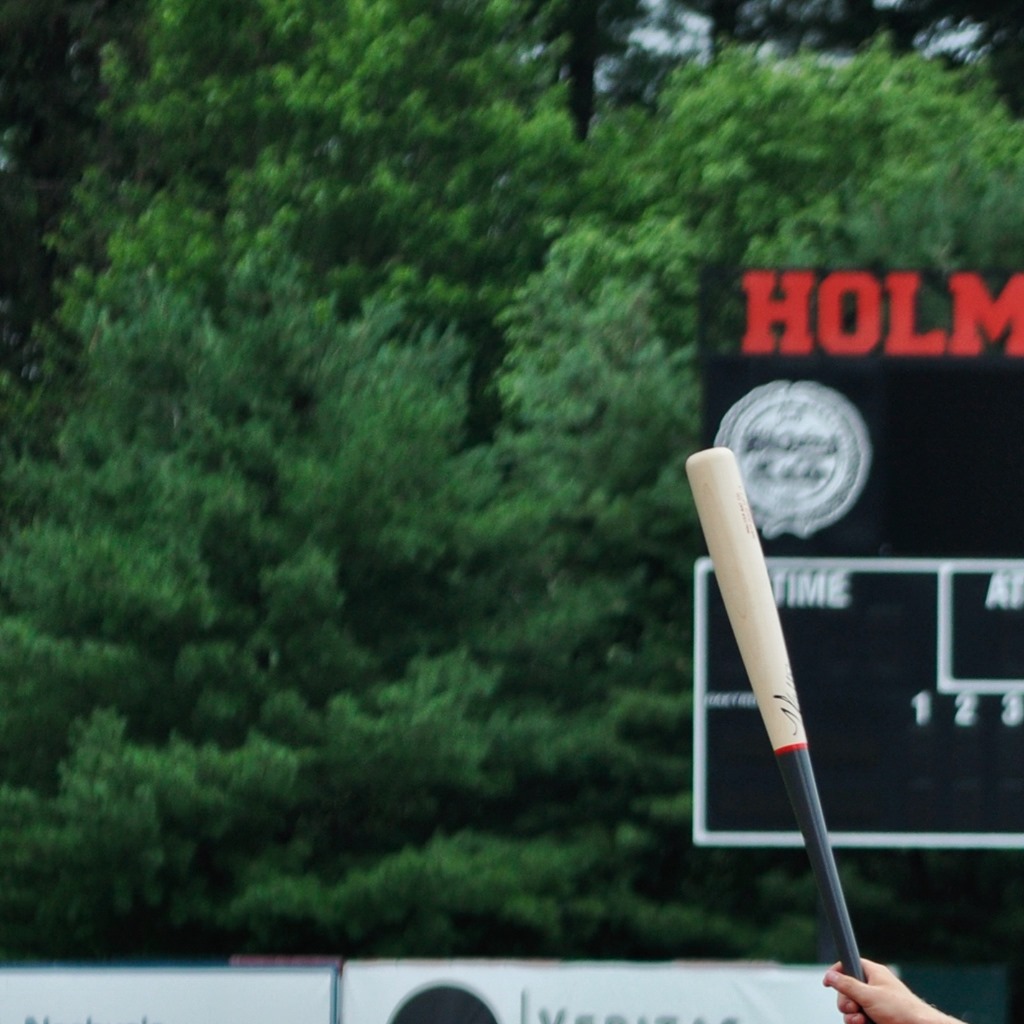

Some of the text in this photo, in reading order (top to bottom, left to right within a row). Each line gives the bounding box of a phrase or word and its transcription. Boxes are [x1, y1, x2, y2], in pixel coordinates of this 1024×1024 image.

[772, 568, 852, 609] TIME
[911, 690, 932, 727] 1
[954, 691, 980, 727] 2
